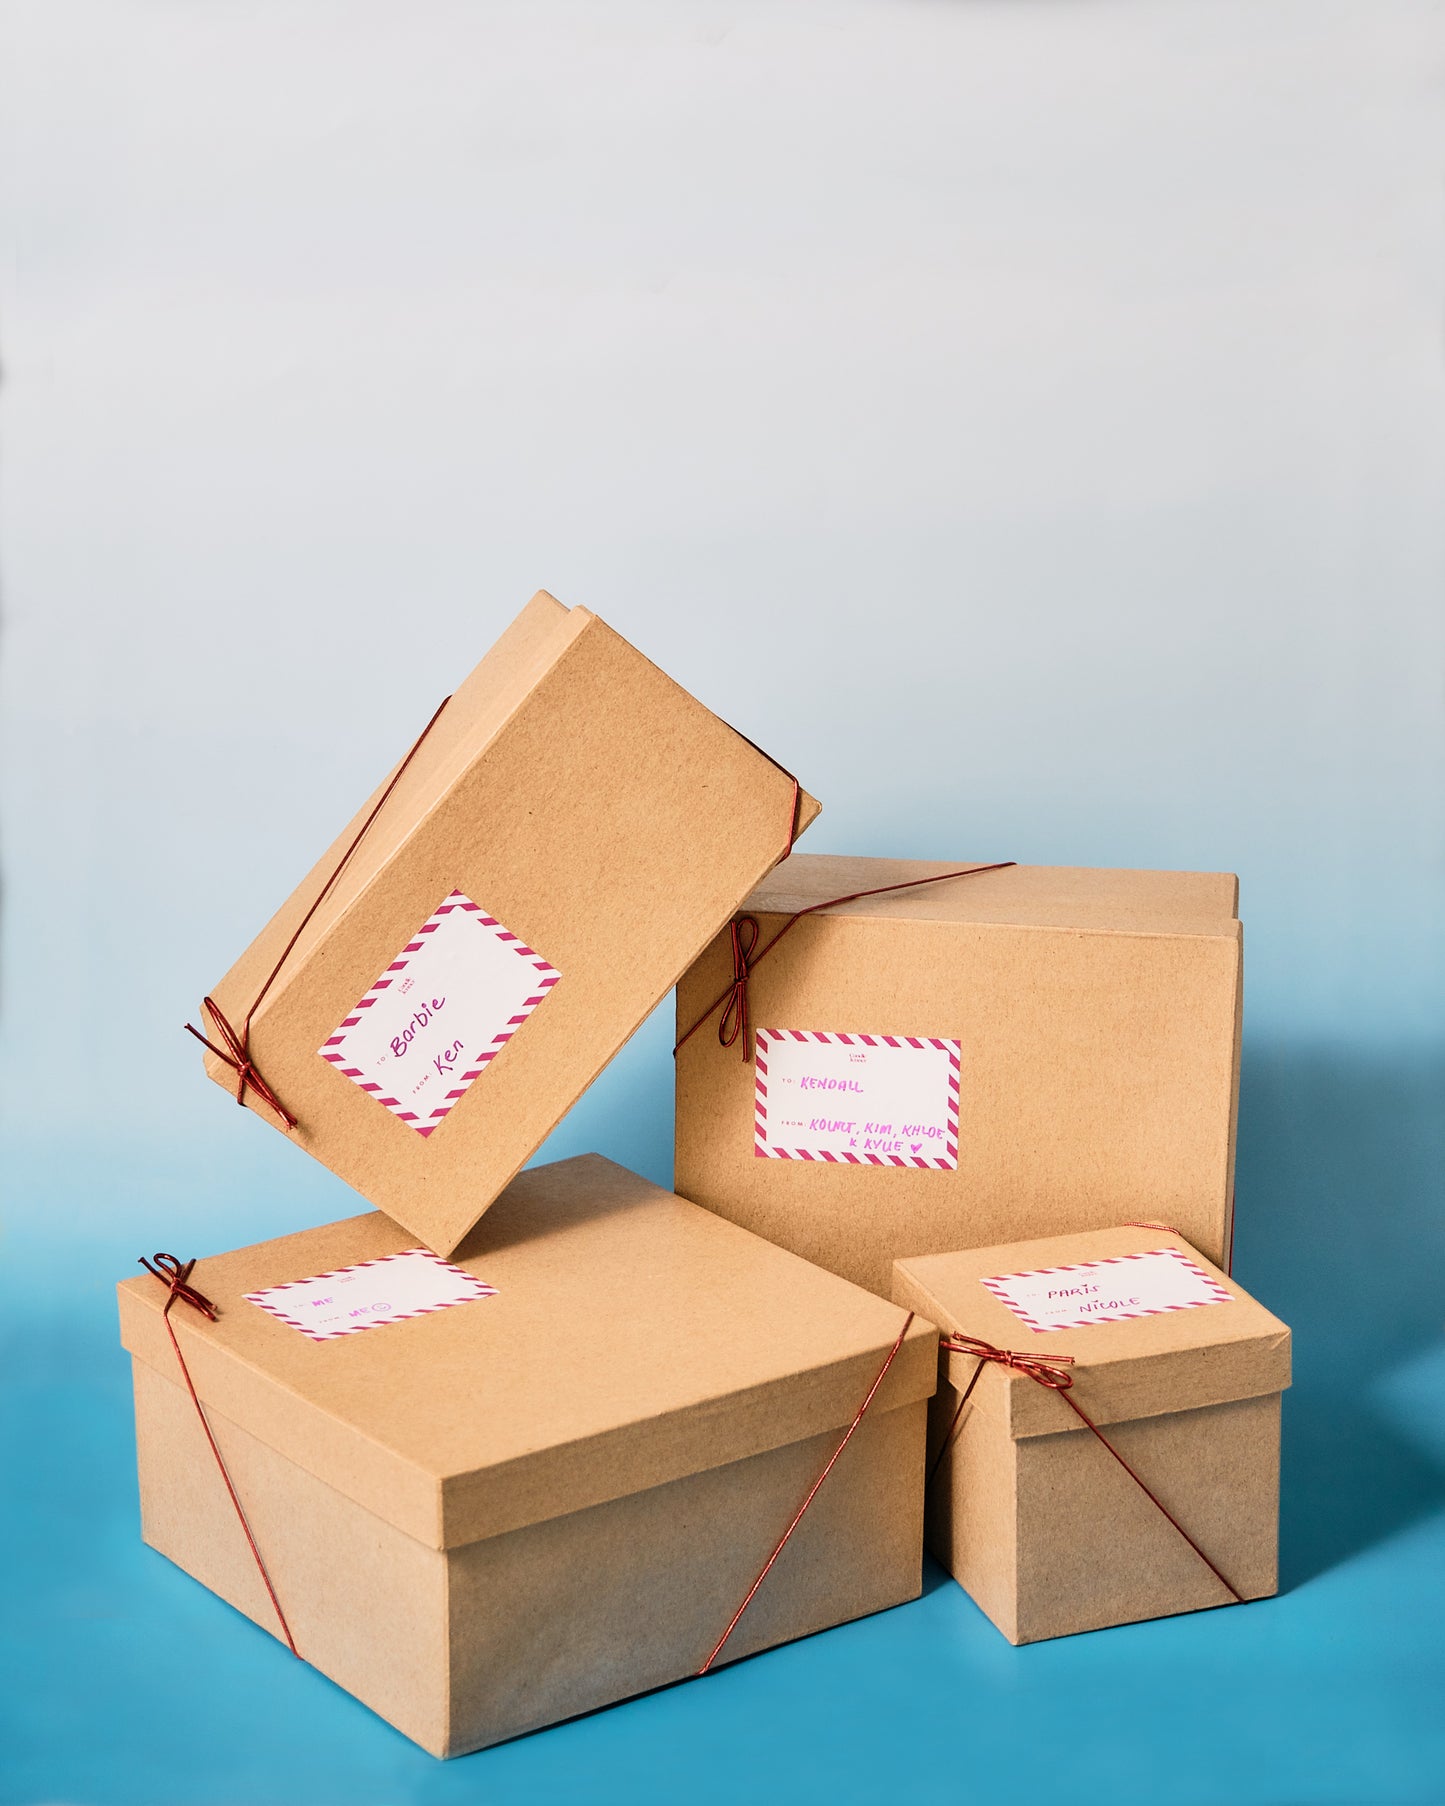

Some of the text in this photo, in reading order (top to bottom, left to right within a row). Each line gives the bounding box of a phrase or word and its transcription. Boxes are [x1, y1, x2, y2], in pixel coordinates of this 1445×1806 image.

[390, 997, 445, 1057] Barbie
[433, 1040, 464, 1075] Ken
[800, 1076, 864, 1093] KENDALL
[864, 1123, 897, 1139] KIM,
[902, 1124, 946, 1140] KHLOE
[311, 1296, 333, 1307] ME
[348, 1307, 370, 1318] ME
